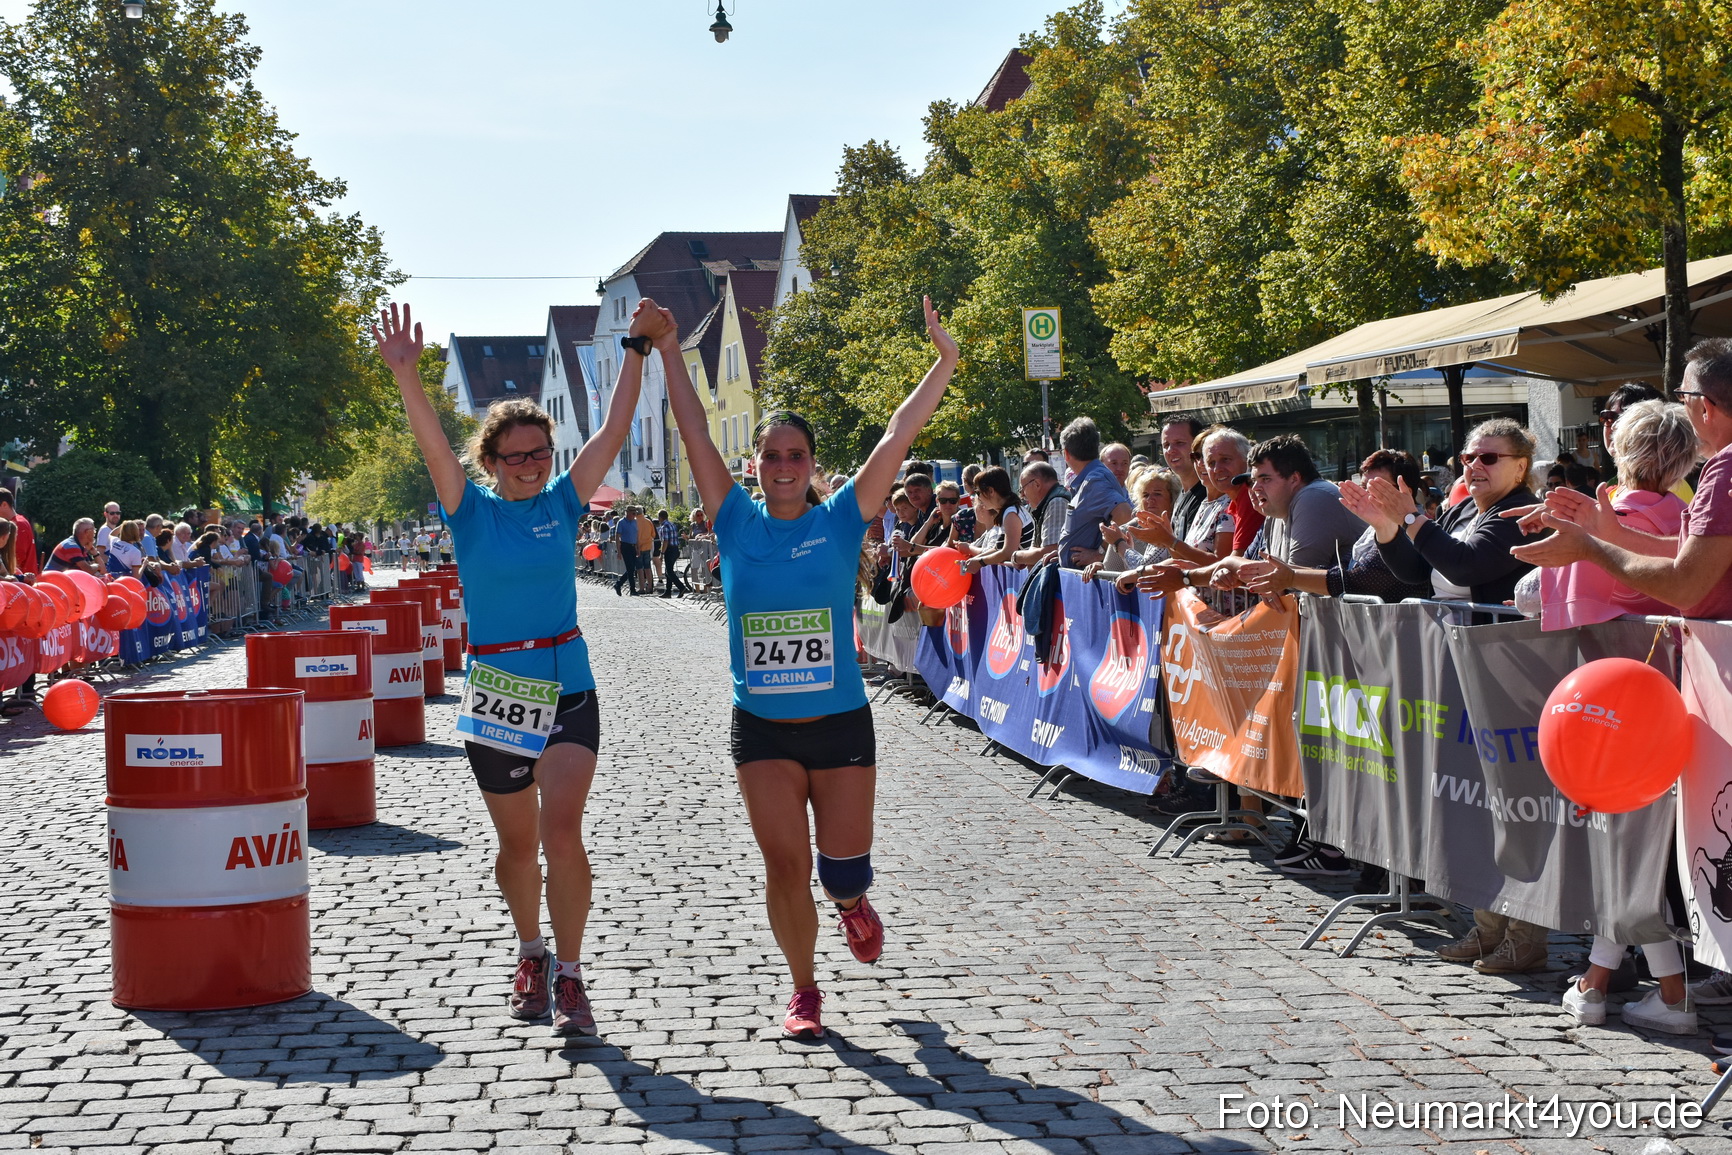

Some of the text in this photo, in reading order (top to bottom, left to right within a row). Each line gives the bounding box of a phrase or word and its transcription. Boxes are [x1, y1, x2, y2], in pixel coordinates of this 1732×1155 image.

[791, 549, 812, 559] Carina
[747, 613, 824, 634] BOCK
[753, 638, 824, 666] 2478
[388, 662, 422, 684] AVIA
[762, 671, 815, 684] CARINA
[475, 667, 551, 702] BOCK
[472, 692, 542, 730] 2481
[1304, 680, 1384, 747] BOCK
[1582, 715, 1619, 730] energie
[481, 724, 524, 745] IRENE
[170, 757, 204, 768] energie
[225, 823, 303, 870] AVIA
